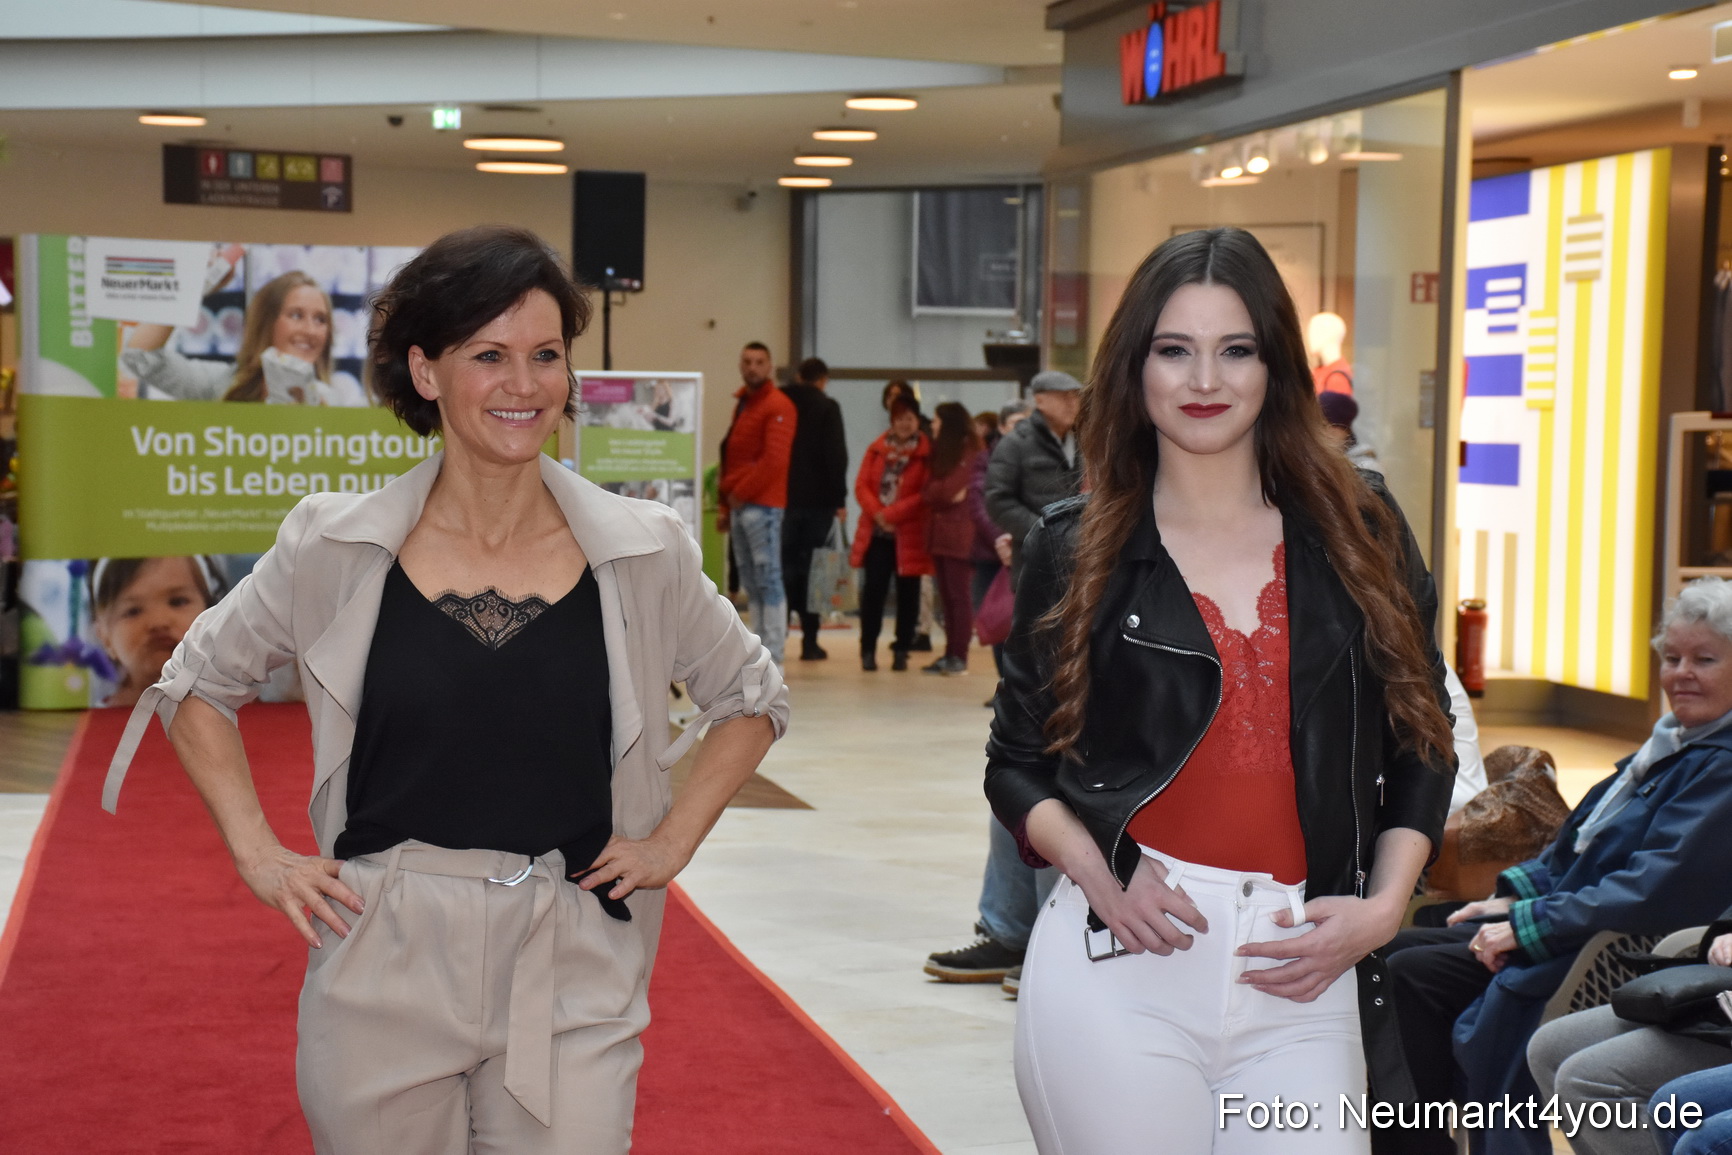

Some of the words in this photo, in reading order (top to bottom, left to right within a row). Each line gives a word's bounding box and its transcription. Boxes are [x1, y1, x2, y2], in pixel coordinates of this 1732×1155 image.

[1120, 0, 1226, 106] WÖHRL
[101, 277, 179, 292] NeuerMarkt
[130, 426, 196, 456] Von
[203, 426, 440, 465] Shoppingtour
[167, 464, 217, 496] bis
[224, 465, 330, 496] Leben
